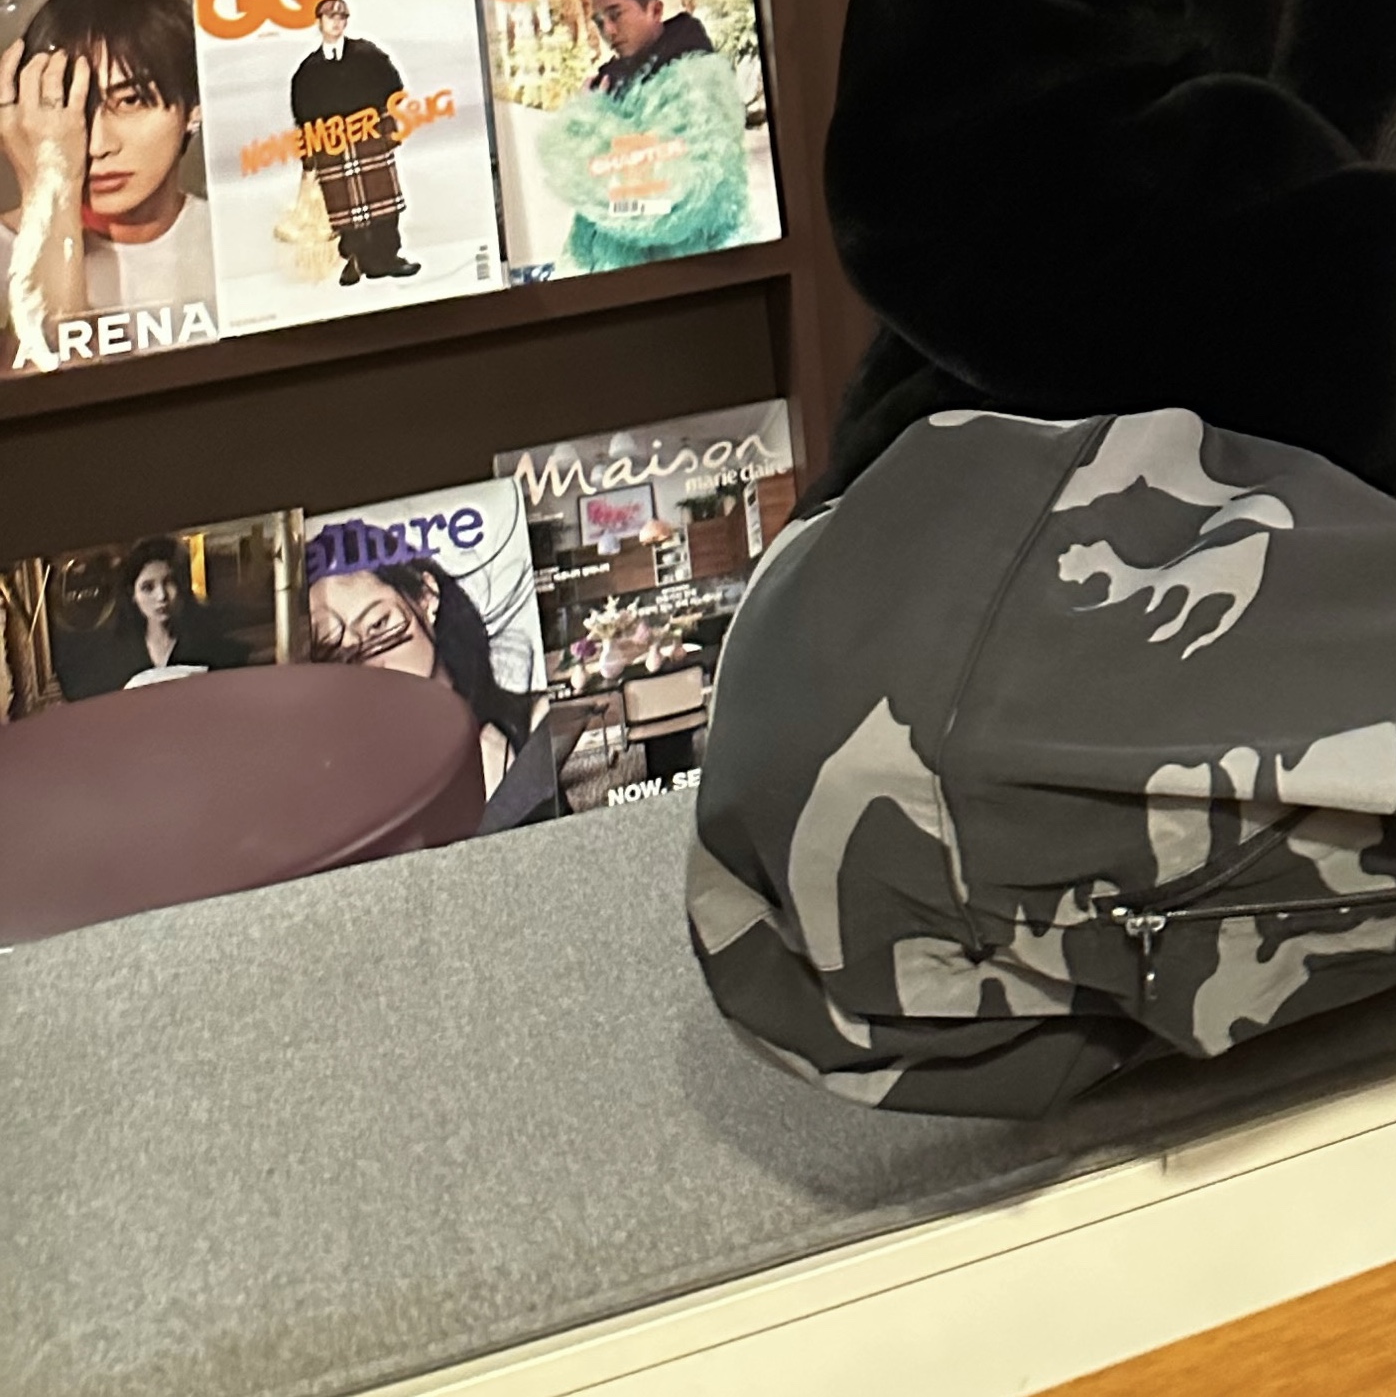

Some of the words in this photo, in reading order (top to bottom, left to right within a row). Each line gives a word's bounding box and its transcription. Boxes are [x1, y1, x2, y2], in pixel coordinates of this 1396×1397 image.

[11, 302, 219, 372] ARENA
[685, 473, 737, 494] marie
[306, 508, 484, 582] allure
[607, 778, 667, 807] NOW.
